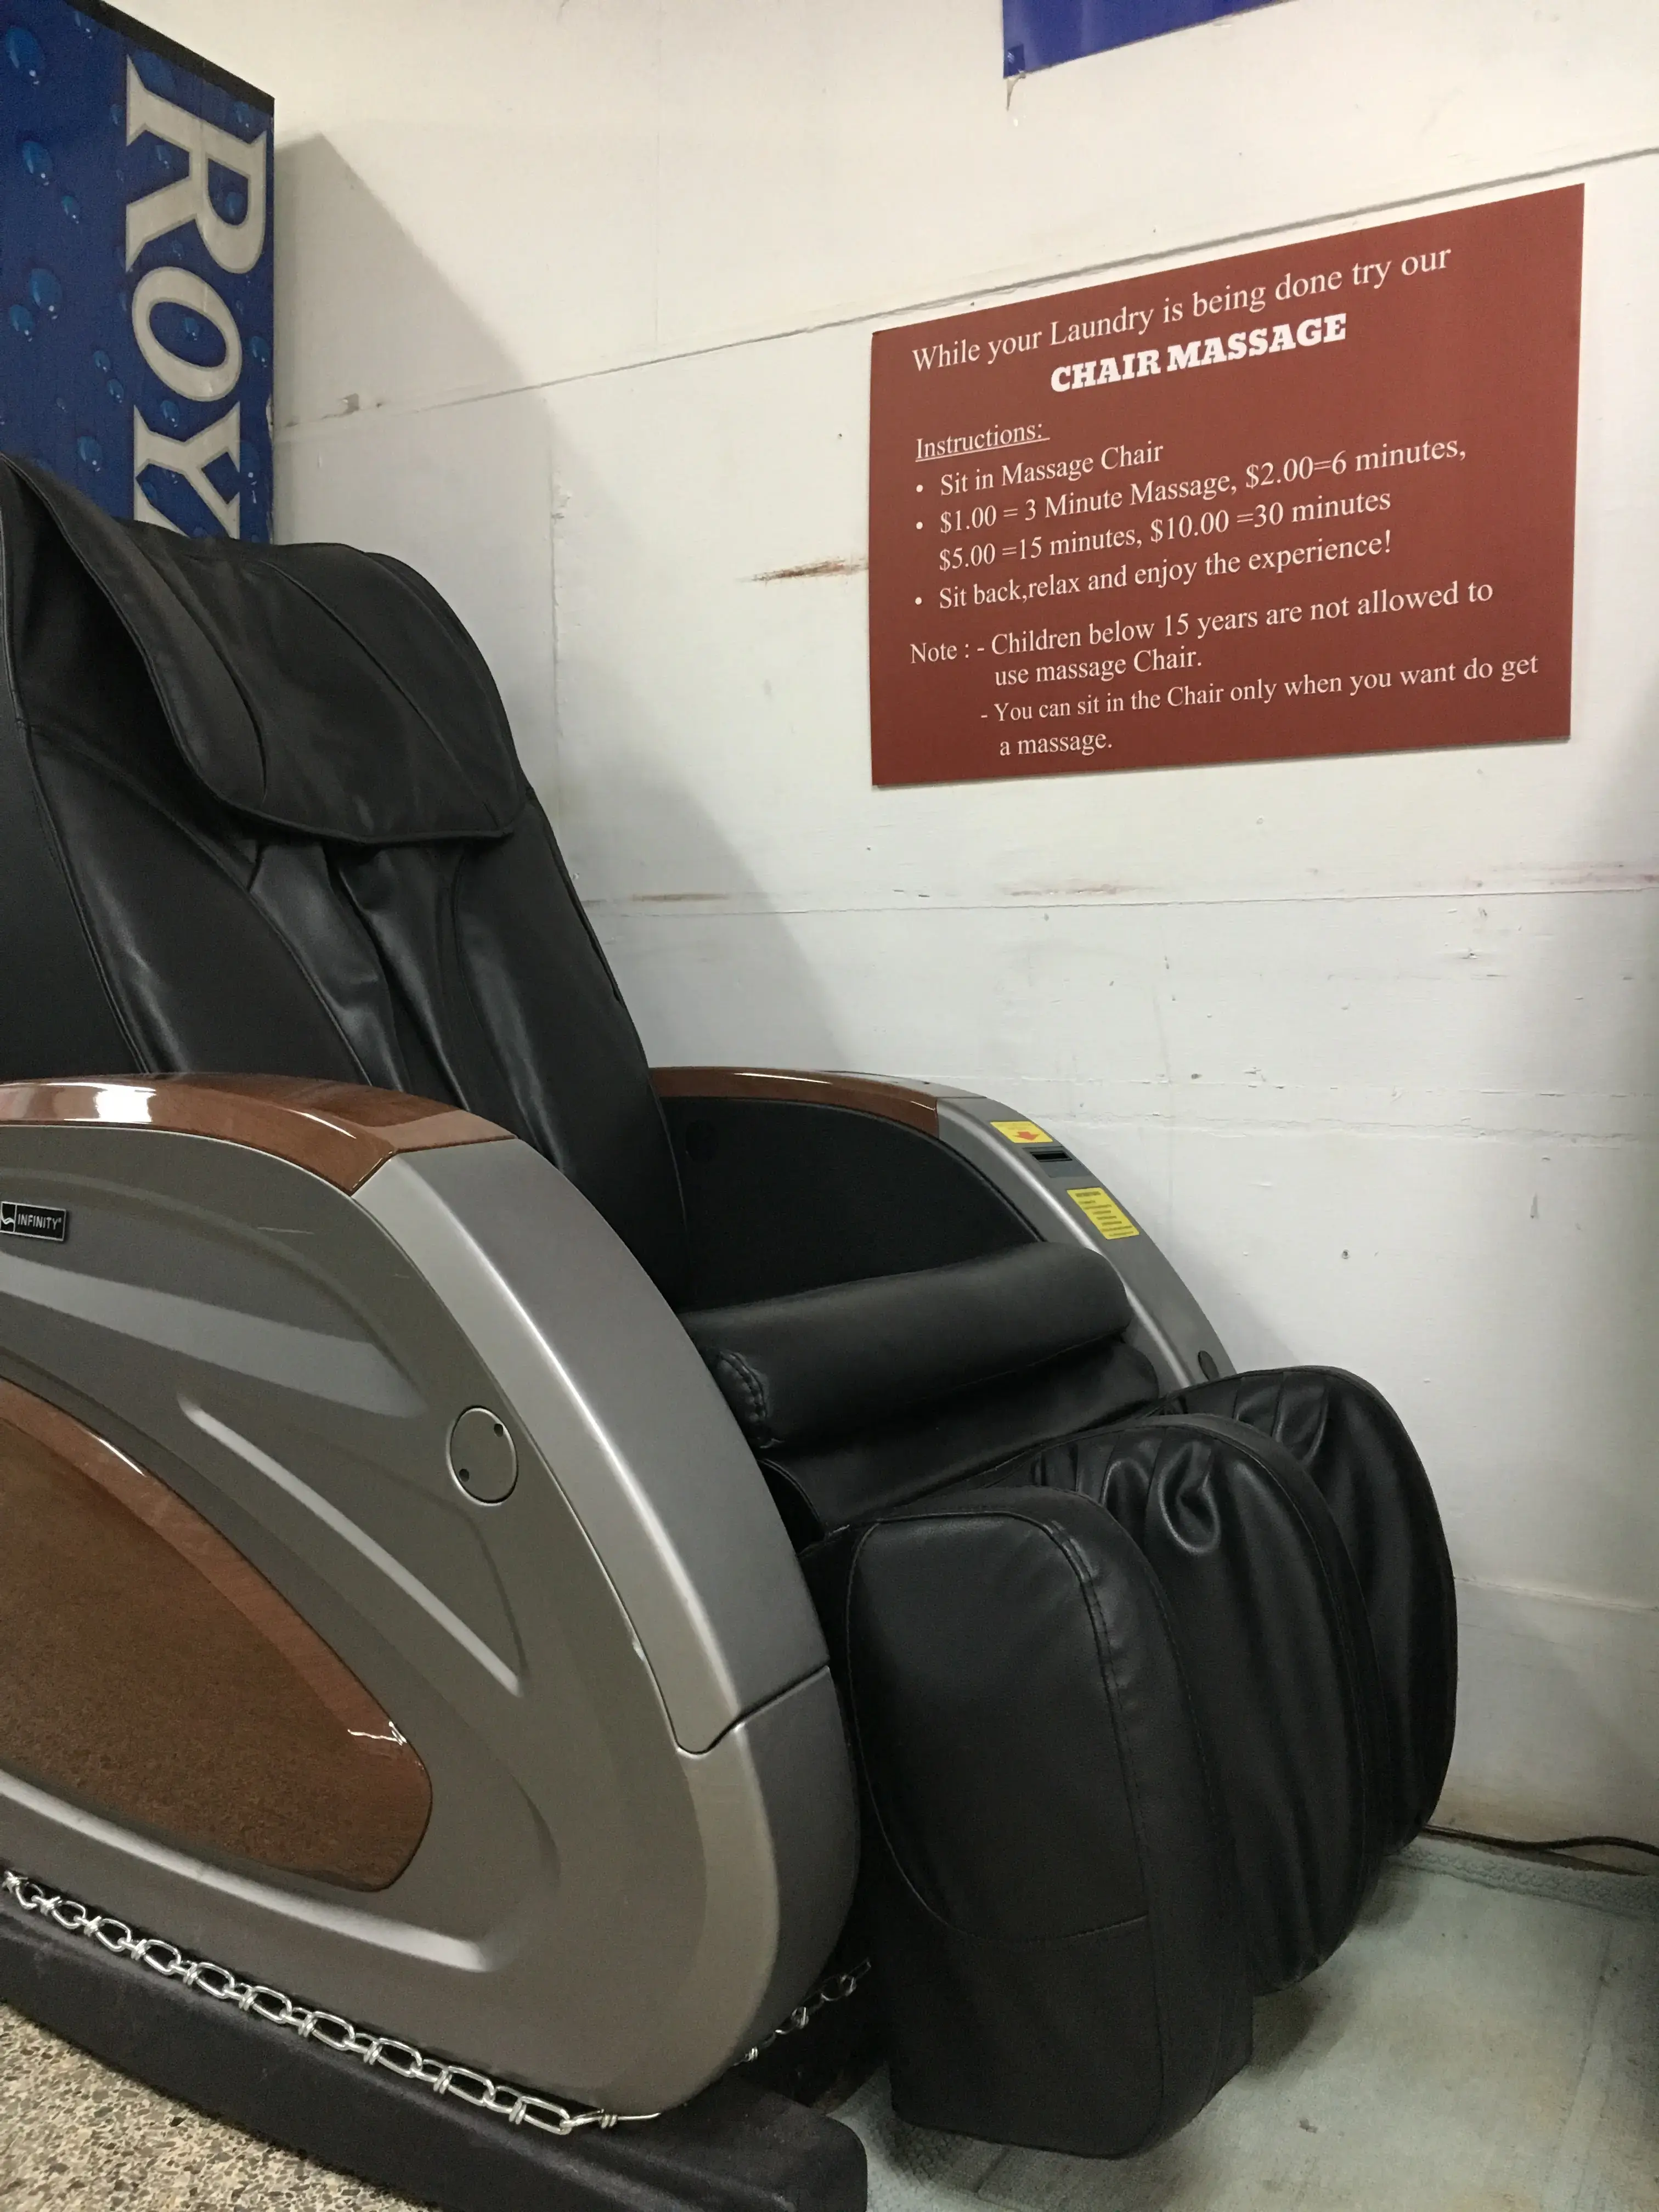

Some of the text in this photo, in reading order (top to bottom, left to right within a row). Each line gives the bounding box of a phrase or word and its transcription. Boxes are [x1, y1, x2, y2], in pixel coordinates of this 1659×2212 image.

[126, 54, 268, 540] ROY
[911, 249, 1452, 371] While your Laundry is being done try our
[1051, 313, 1347, 392] CHAIR MASSAGE
[915, 423, 1051, 462] Instructions:
[941, 440, 1164, 496] Sit in Massage Chair
[940, 505, 997, 534] $1.00
[1025, 499, 1036, 521] 3
[1045, 489, 1122, 518] Minute
[1129, 476, 1237, 506] Massage,
[1355, 440, 1466, 472] minutes,
[939, 543, 996, 572] $5.00
[1049, 529, 1142, 556] minutes,
[1150, 510, 1229, 544] $10.00
[1291, 493, 1391, 522] minutes
[940, 585, 967, 609] Sit
[1088, 564, 1127, 591] and
[1135, 558, 1198, 589] enjoy
[1204, 551, 1240, 576] the
[1248, 529, 1391, 574] experience!
[910, 642, 957, 664] Note
[991, 628, 1081, 655] Children
[1088, 620, 1155, 645] below
[1165, 613, 1189, 637] 15
[1197, 611, 1258, 640] years
[1266, 606, 1302, 625] are
[1310, 596, 1350, 621] not
[1357, 580, 1459, 615] allowed
[1468, 582, 1493, 602] to
[994, 702, 1033, 721] You
[1039, 702, 1071, 718] can
[1077, 694, 1100, 715] sit
[1106, 692, 1124, 712] in
[1130, 690, 1161, 710] the
[1167, 682, 1224, 707] Chair
[1230, 678, 1277, 704] only
[1284, 674, 1342, 696] when
[1349, 673, 1392, 696] you
[1400, 663, 1456, 685] want
[1463, 657, 1493, 680] do
[1500, 655, 1539, 682] get
[995, 645, 1202, 686] use massage Chair.
[1000, 733, 1112, 756] a massage.
[18, 1213, 58, 1231] INFINITY
